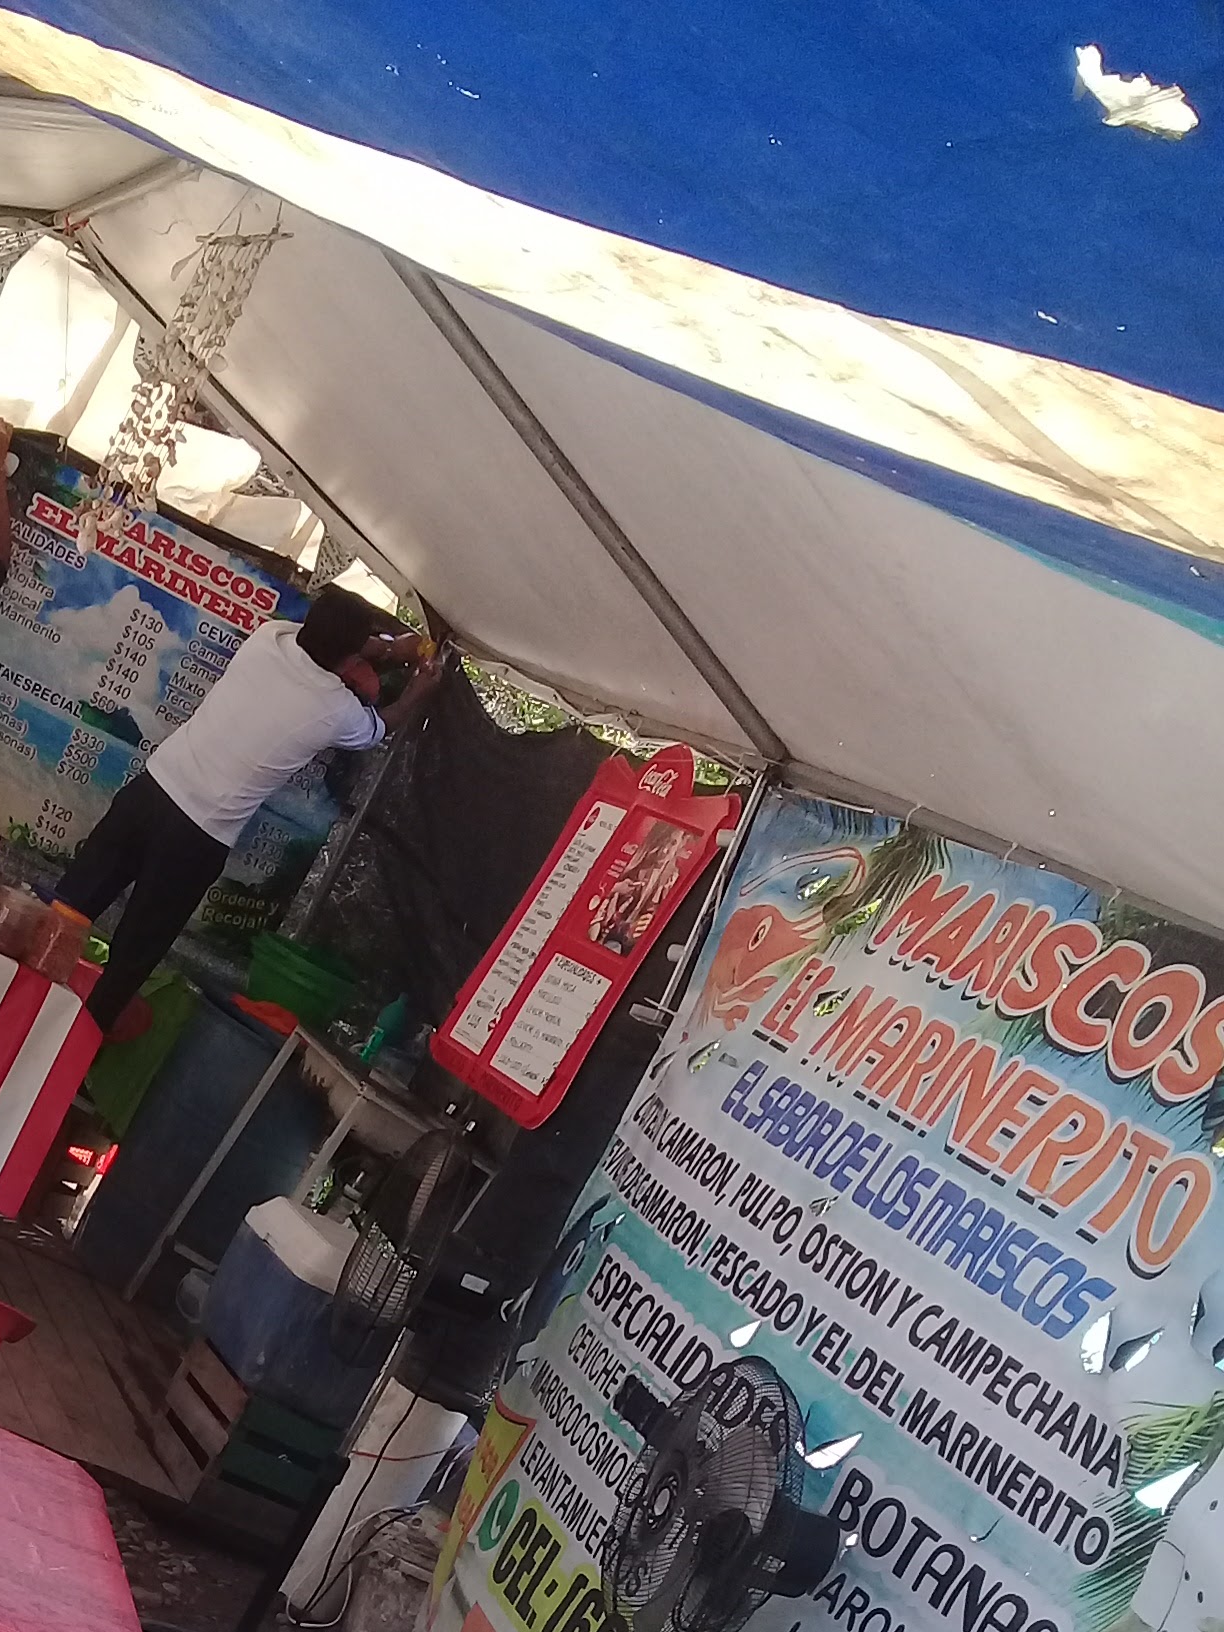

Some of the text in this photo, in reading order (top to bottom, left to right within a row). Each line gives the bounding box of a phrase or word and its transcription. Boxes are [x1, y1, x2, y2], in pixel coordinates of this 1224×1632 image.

[30, 496, 78, 539] EL
[121, 515, 278, 612] ARISCOS
[2, 585, 42, 612] opical
[130, 608, 164, 634] $130
[198, 621, 242, 651] CEVIC
[122, 625, 156, 651] $105
[114, 641, 148, 668] $140
[106, 658, 139, 684] $140
[171, 672, 206, 699] Mixto
[14, 671, 83, 719] ESPECIAL
[90, 691, 116, 713] $60
[97, 674, 131, 700] $140
[71, 728, 106, 753] $330
[63, 744, 97, 769] $500
[56, 760, 91, 786] $700
[41, 799, 73, 823] $120
[35, 815, 66, 839] $140
[871, 874, 1224, 1098] MARISCOS
[761, 957, 1214, 1269] EL MARINERITO
[721, 1060, 769, 1122] EL
[745, 1076, 843, 1169] SABOR
[852, 1142, 939, 1231] LOS
[906, 1178, 1117, 1340] MARISCOS
[701, 1234, 804, 1331] PESCADO
[657, 1117, 741, 1206] CAMARON,
[729, 1172, 804, 1257] PULPO,
[798, 1223, 901, 1316] OSTION
[886, 1285, 924, 1329] Y
[908, 1304, 1123, 1489] CAMPECHANA
[795, 1305, 828, 1347] Y
[567, 1323, 627, 1400] CEVICHE
[811, 1321, 853, 1376] EL
[844, 1346, 905, 1418] DEL
[898, 1387, 1110, 1566] MARINERITO
